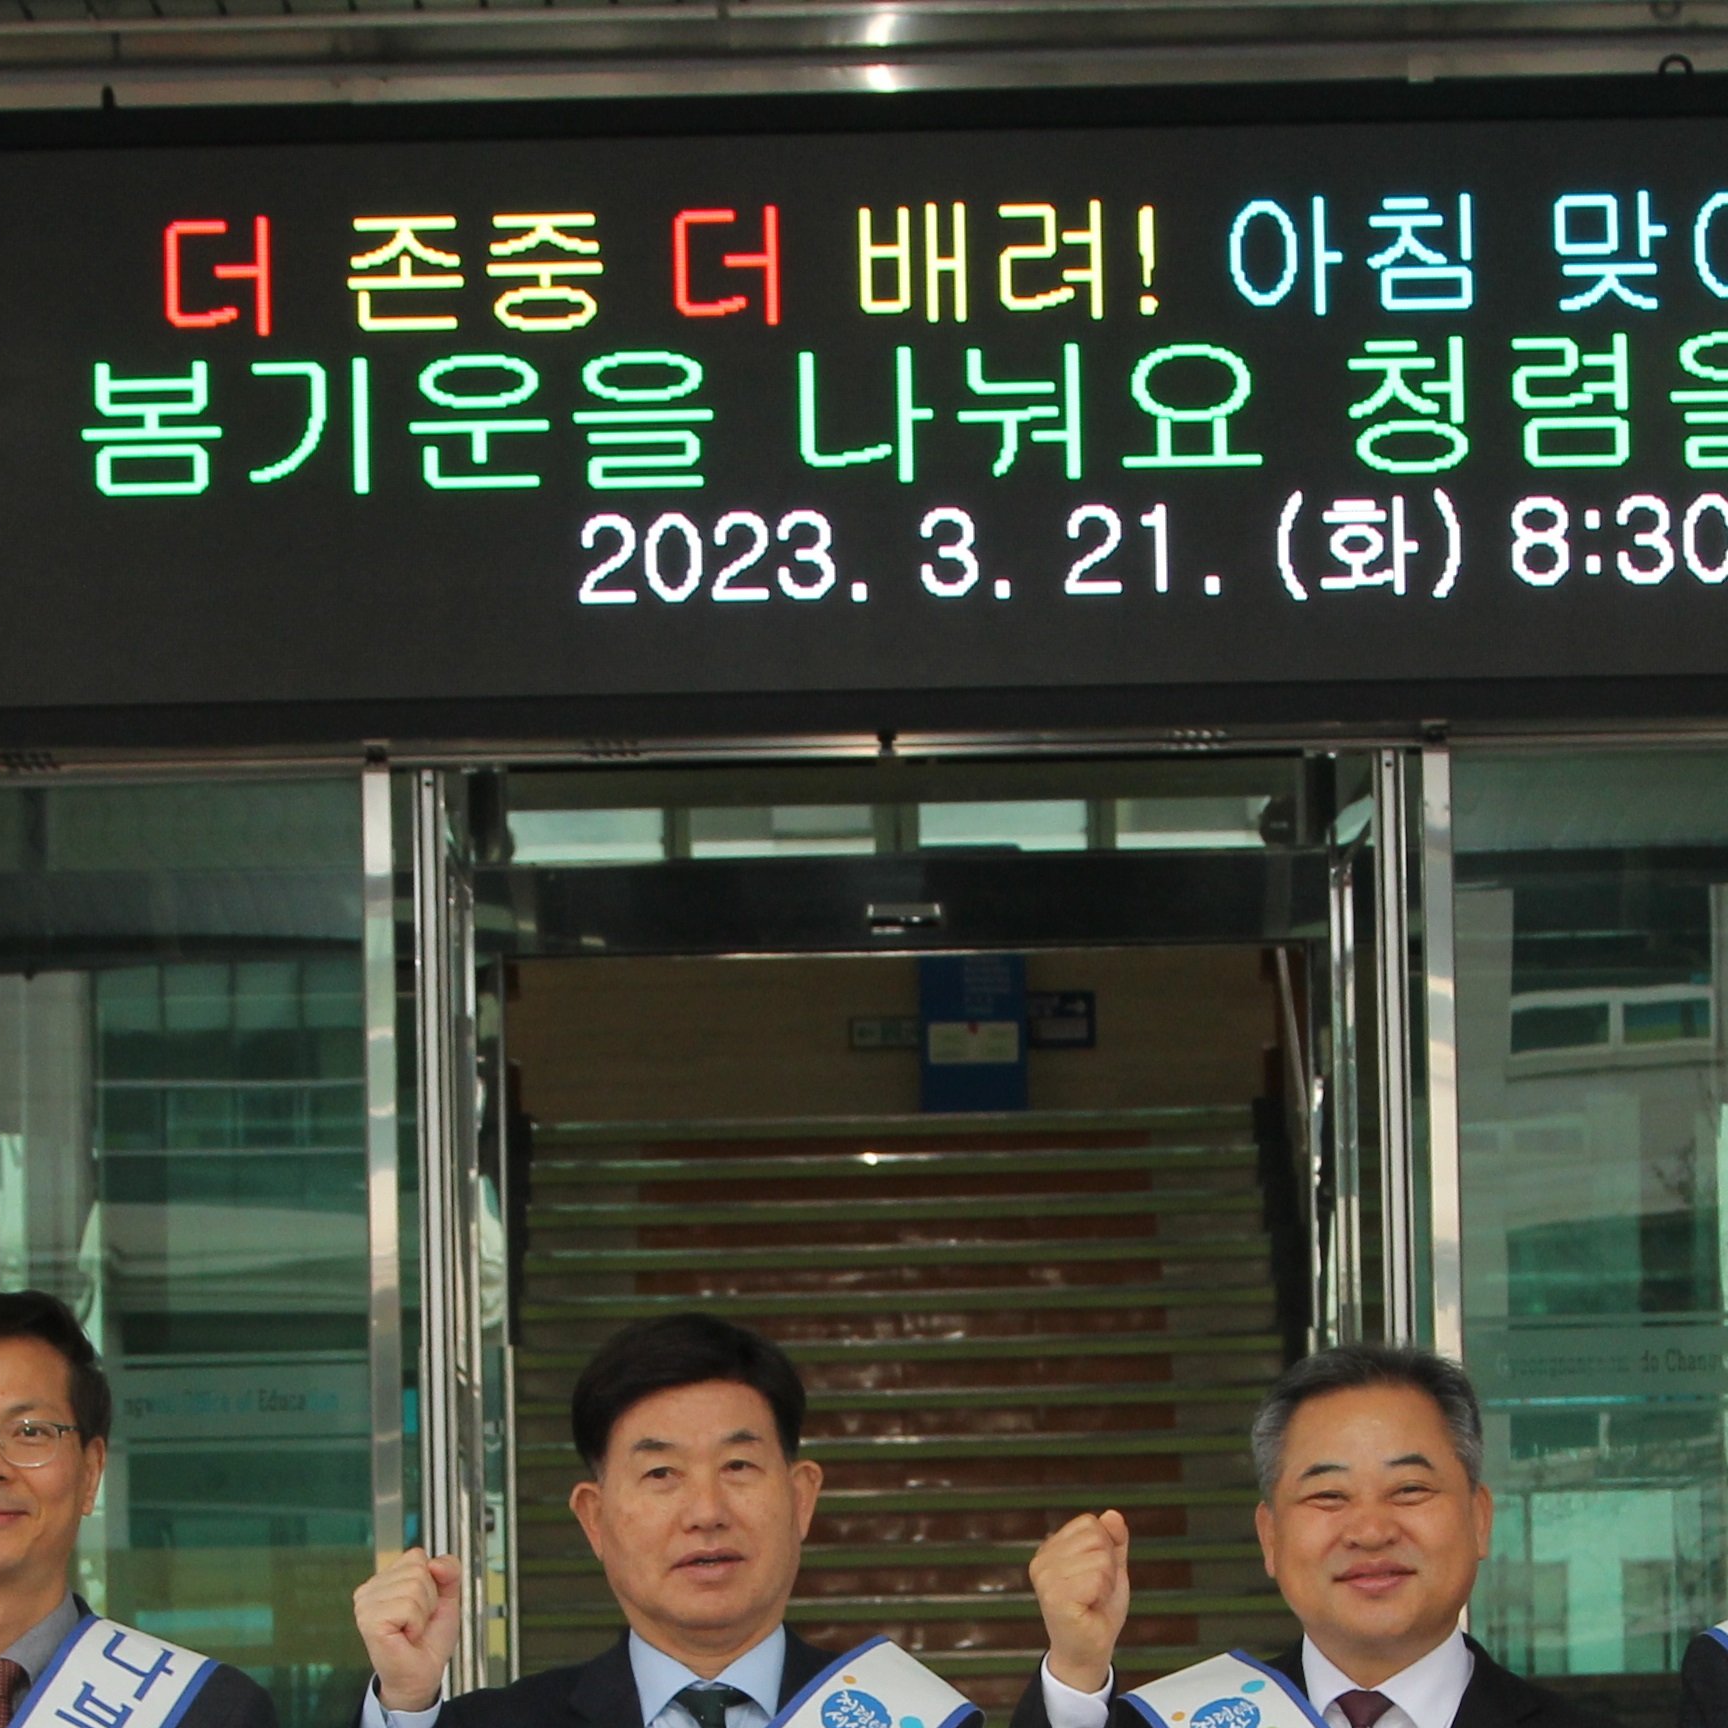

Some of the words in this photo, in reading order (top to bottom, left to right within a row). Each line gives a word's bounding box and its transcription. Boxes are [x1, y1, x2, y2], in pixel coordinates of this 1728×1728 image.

[164, 215, 271, 336] 더
[347, 212, 603, 333] 존중
[673, 205, 780, 325] 더
[859, 199, 1158, 322] 배려!
[1230, 193, 1473, 315] 아침
[81, 351, 714, 496] 봄기운을
[799, 343, 1262, 483] 나눠요
[579, 510, 867, 604] 2023.
[920, 507, 1010, 599] 3.
[1065, 503, 1220, 595] 21.
[1278, 488, 1461, 600] (화)
